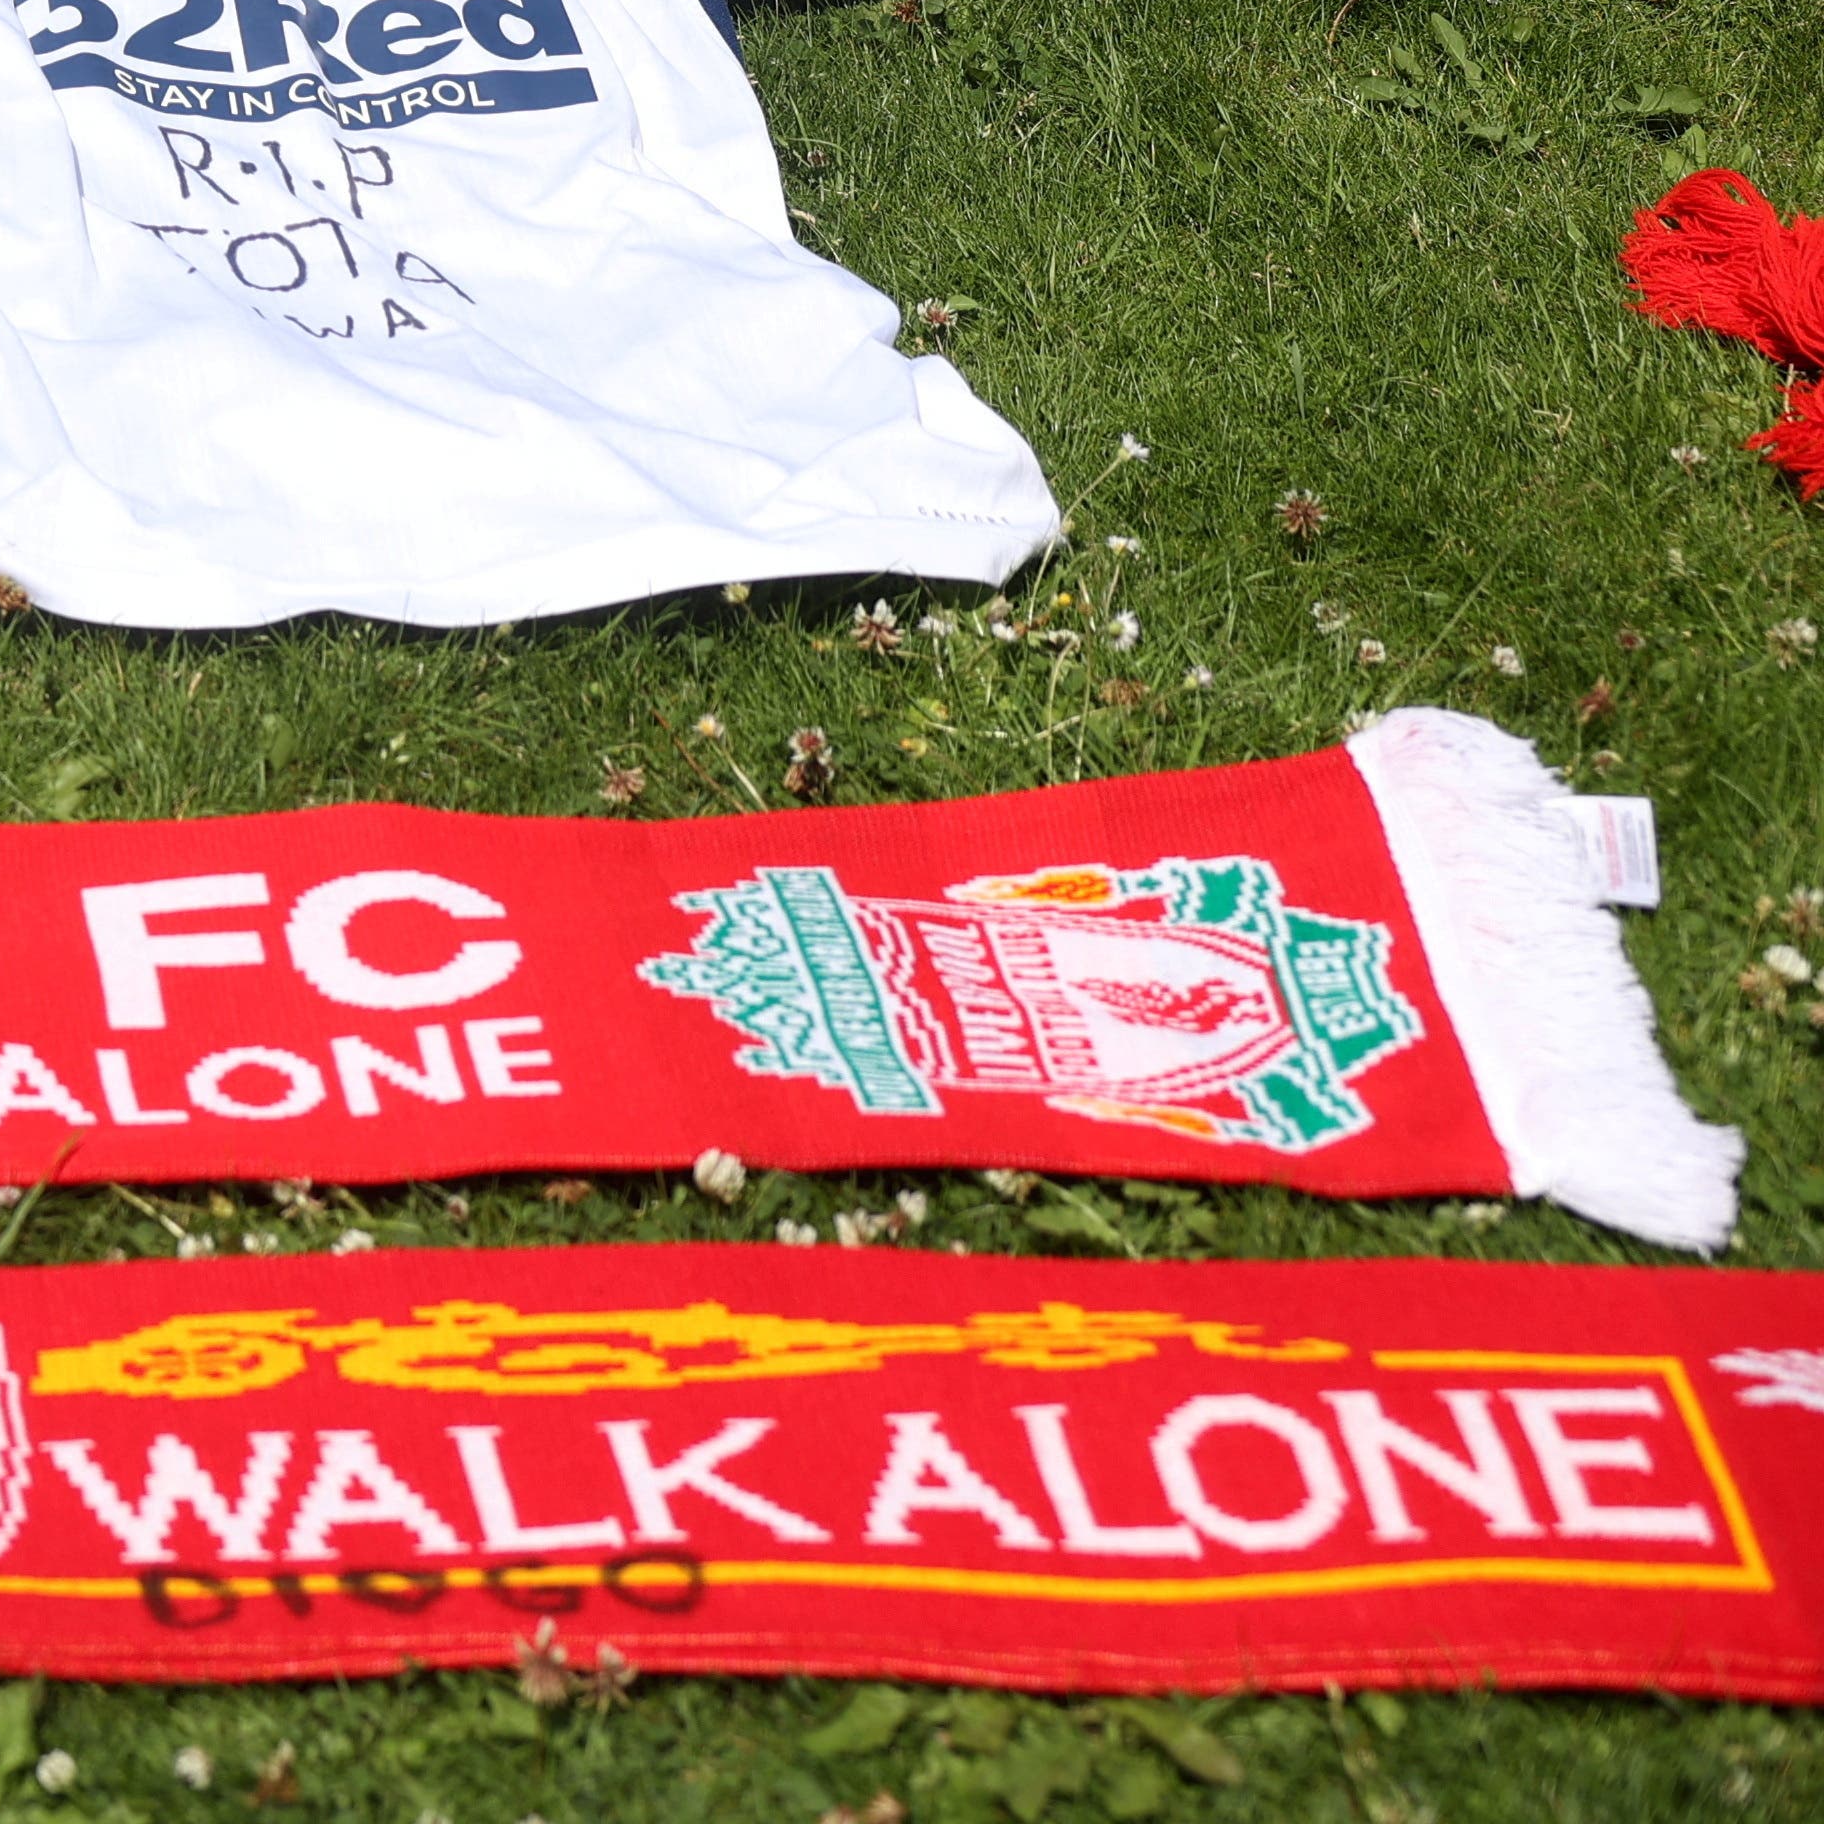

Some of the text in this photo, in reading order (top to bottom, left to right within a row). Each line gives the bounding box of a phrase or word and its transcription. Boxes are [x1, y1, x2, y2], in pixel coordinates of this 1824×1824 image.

[113, 68, 496, 126] STAY IN CONTROL
[81, 870, 522, 1030] FC
[917, 920, 1043, 1080] LIVERPOOL
[43, 1417, 831, 1563] WALK
[866, 1387, 1714, 1558] ALONE
[144, 1549, 706, 1629] DIOGO
